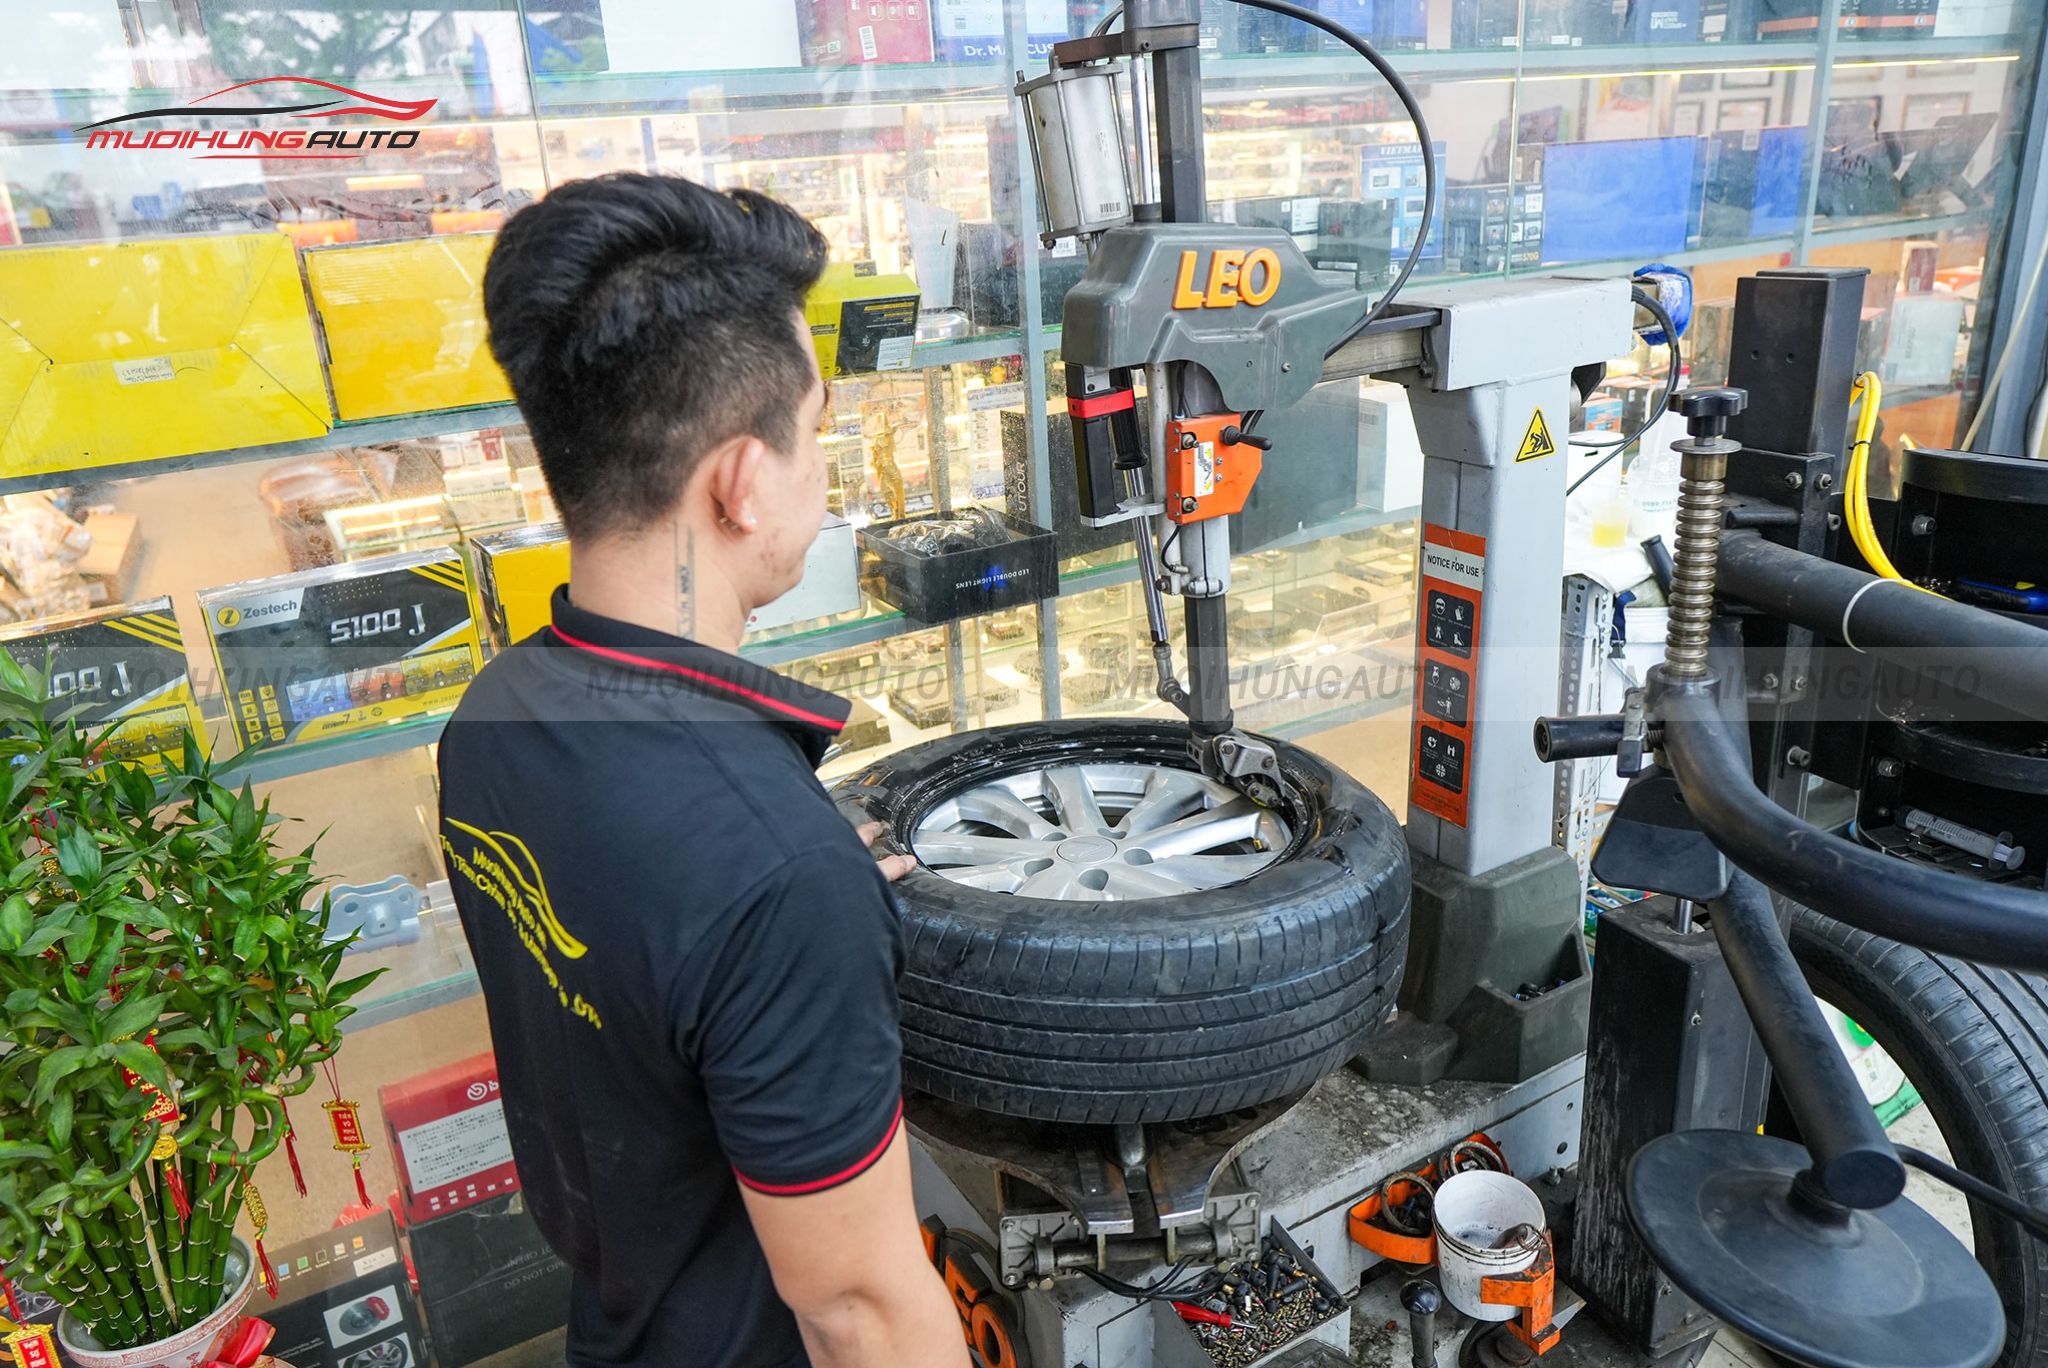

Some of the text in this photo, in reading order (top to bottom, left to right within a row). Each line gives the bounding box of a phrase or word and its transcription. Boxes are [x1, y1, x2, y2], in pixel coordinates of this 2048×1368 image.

[964, 44, 988, 57] Dr.
[1172, 247, 1282, 310] LEO
[1427, 554, 1480, 578] NOTICE FOR USE
[243, 600, 297, 620] Zestech
